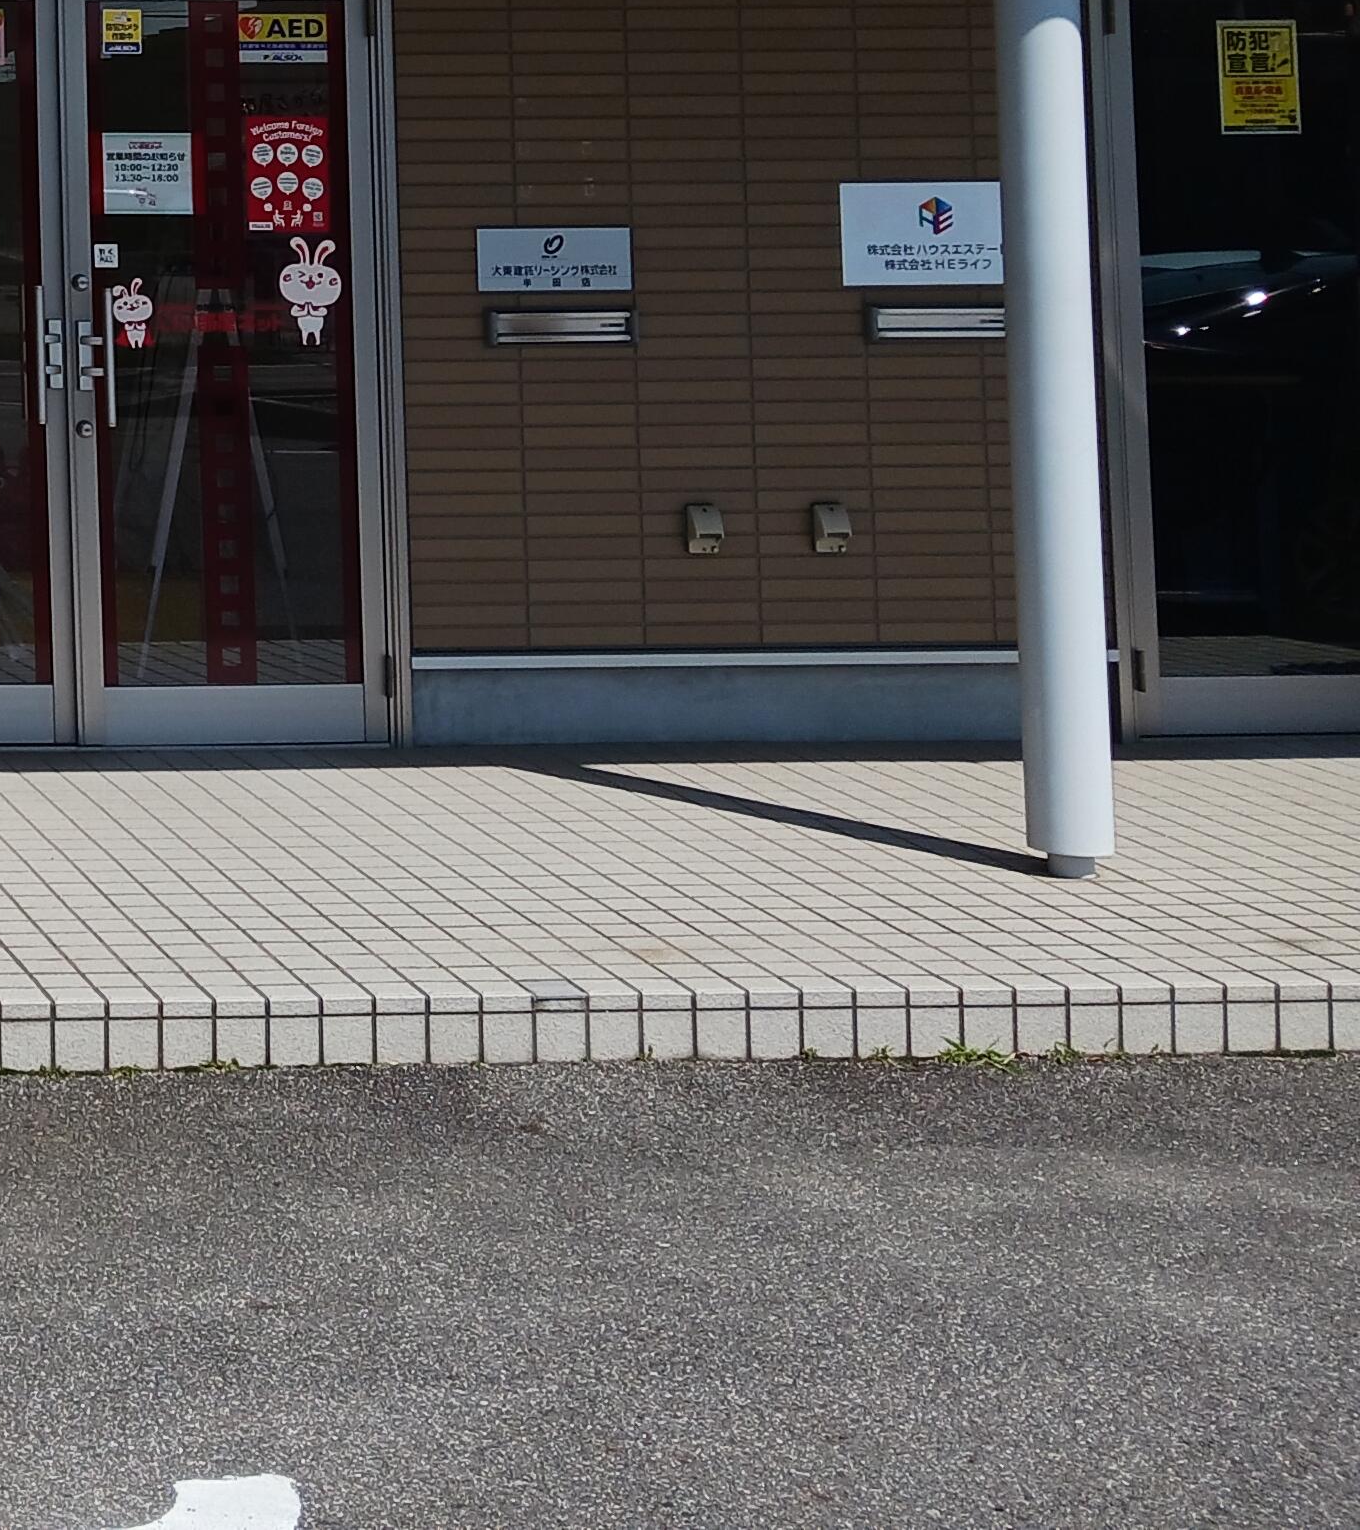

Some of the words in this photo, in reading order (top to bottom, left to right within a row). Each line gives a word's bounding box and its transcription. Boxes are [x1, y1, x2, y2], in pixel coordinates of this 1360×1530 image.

[266, 19, 324, 38] AED
[1226, 31, 1269, 51] 防犯
[250, 121, 290, 136] Welcome
[291, 120, 324, 136] Foreign
[106, 153, 185, 162] 営業時間のお知らせ
[492, 265, 617, 276] 大東建託リーシング株式会社
